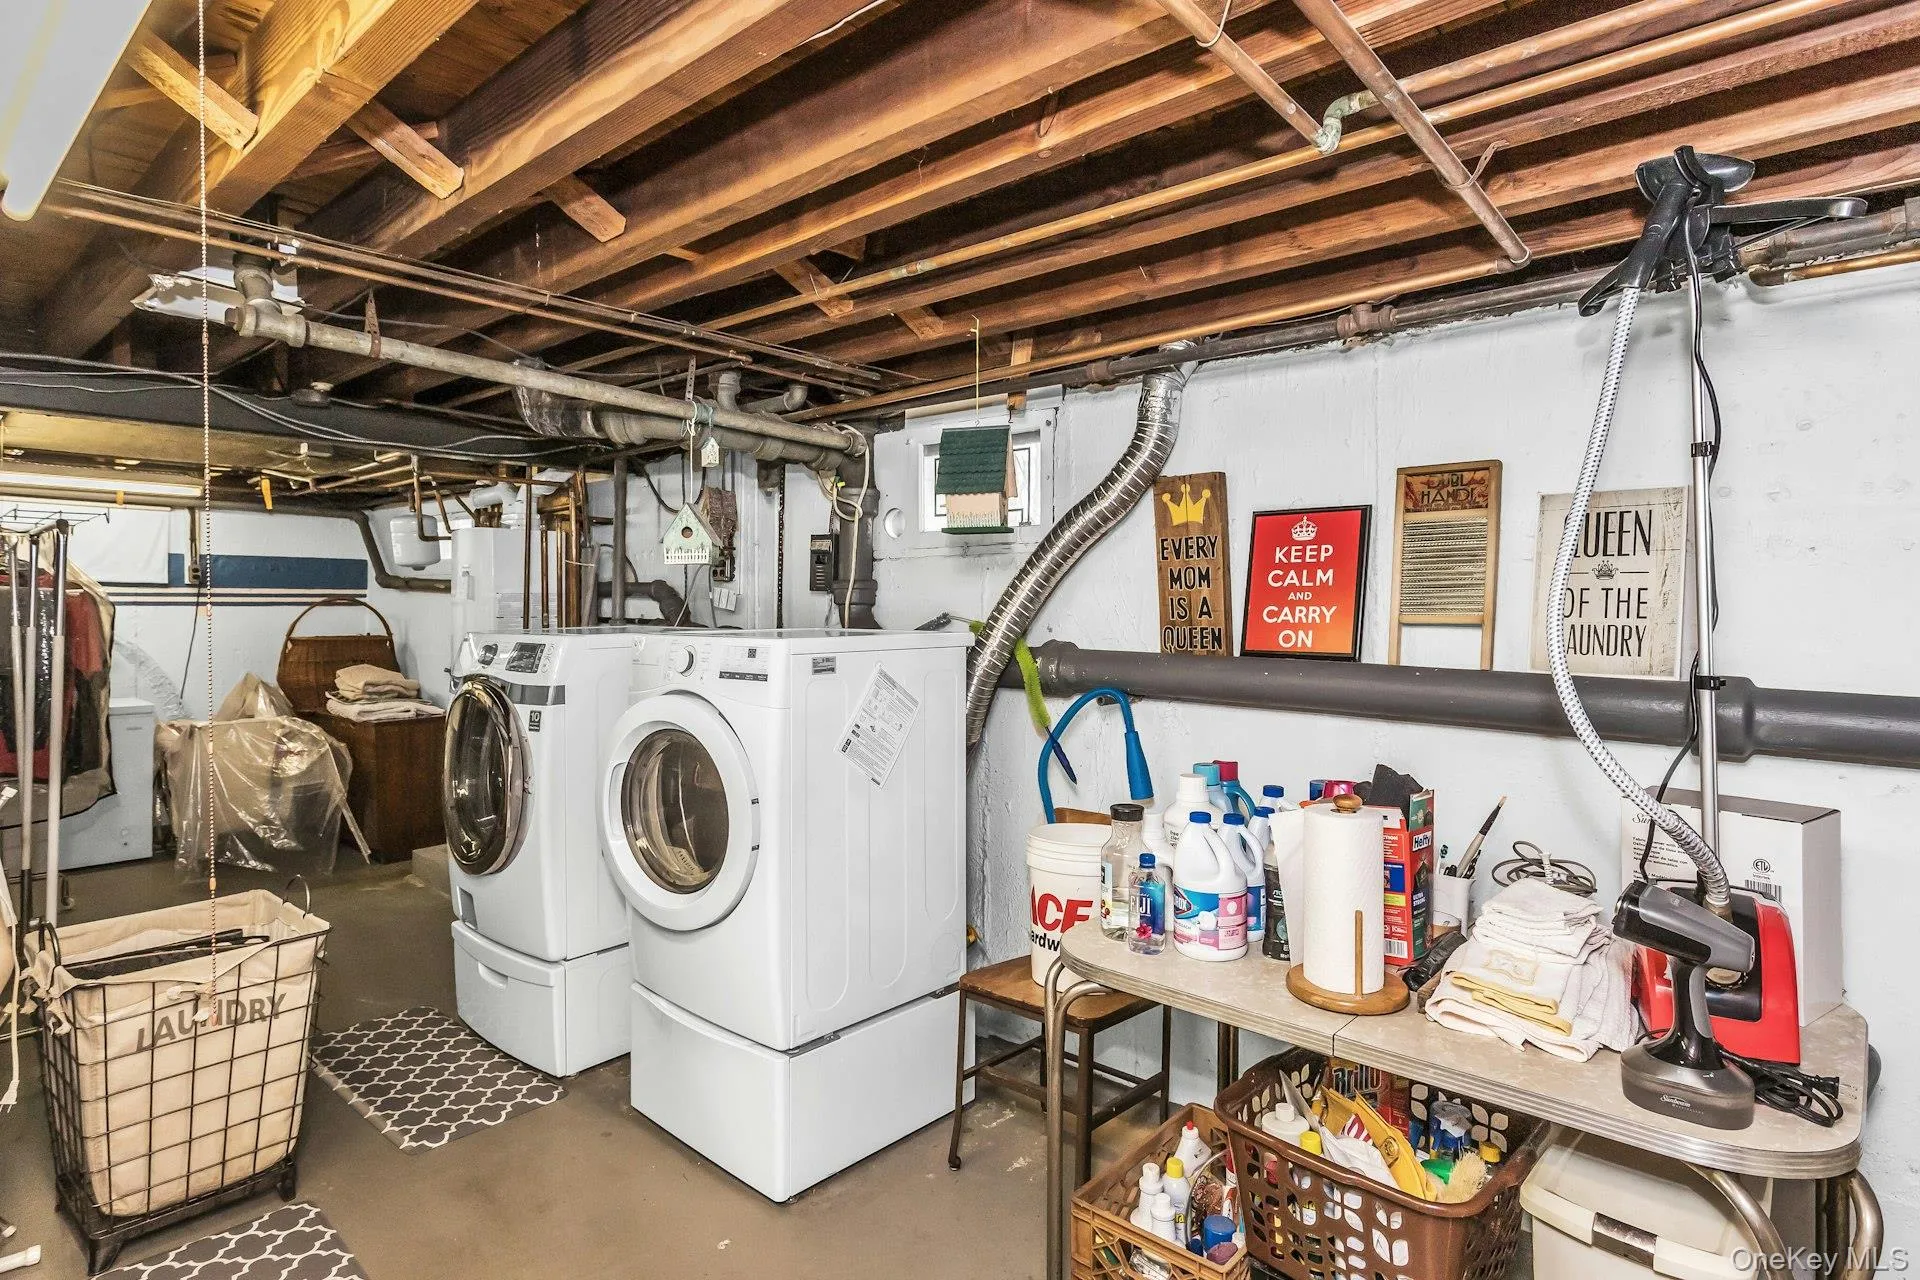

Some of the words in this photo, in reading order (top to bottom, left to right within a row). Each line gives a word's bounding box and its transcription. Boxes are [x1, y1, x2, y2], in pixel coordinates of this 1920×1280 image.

[1160, 535, 1218, 561] EVERY
[1274, 544, 1334, 563] KEEP
[1169, 566, 1211, 590] MOM
[1267, 568, 1334, 587] CALM
[1288, 591, 1312, 600] AND
[1601, 587, 1648, 619] THE
[1169, 597, 1188, 620] IS
[1197, 596, 1213, 619] A
[1262, 605, 1337, 624] CARRY
[1162, 626, 1223, 653] QUEEN
[1278, 629, 1313, 648] ON
[1566, 623, 1647, 657] AUNDRY
[1413, 834, 1431, 849] Hefty
[1660, 1094, 1691, 1107] Sunbeam
